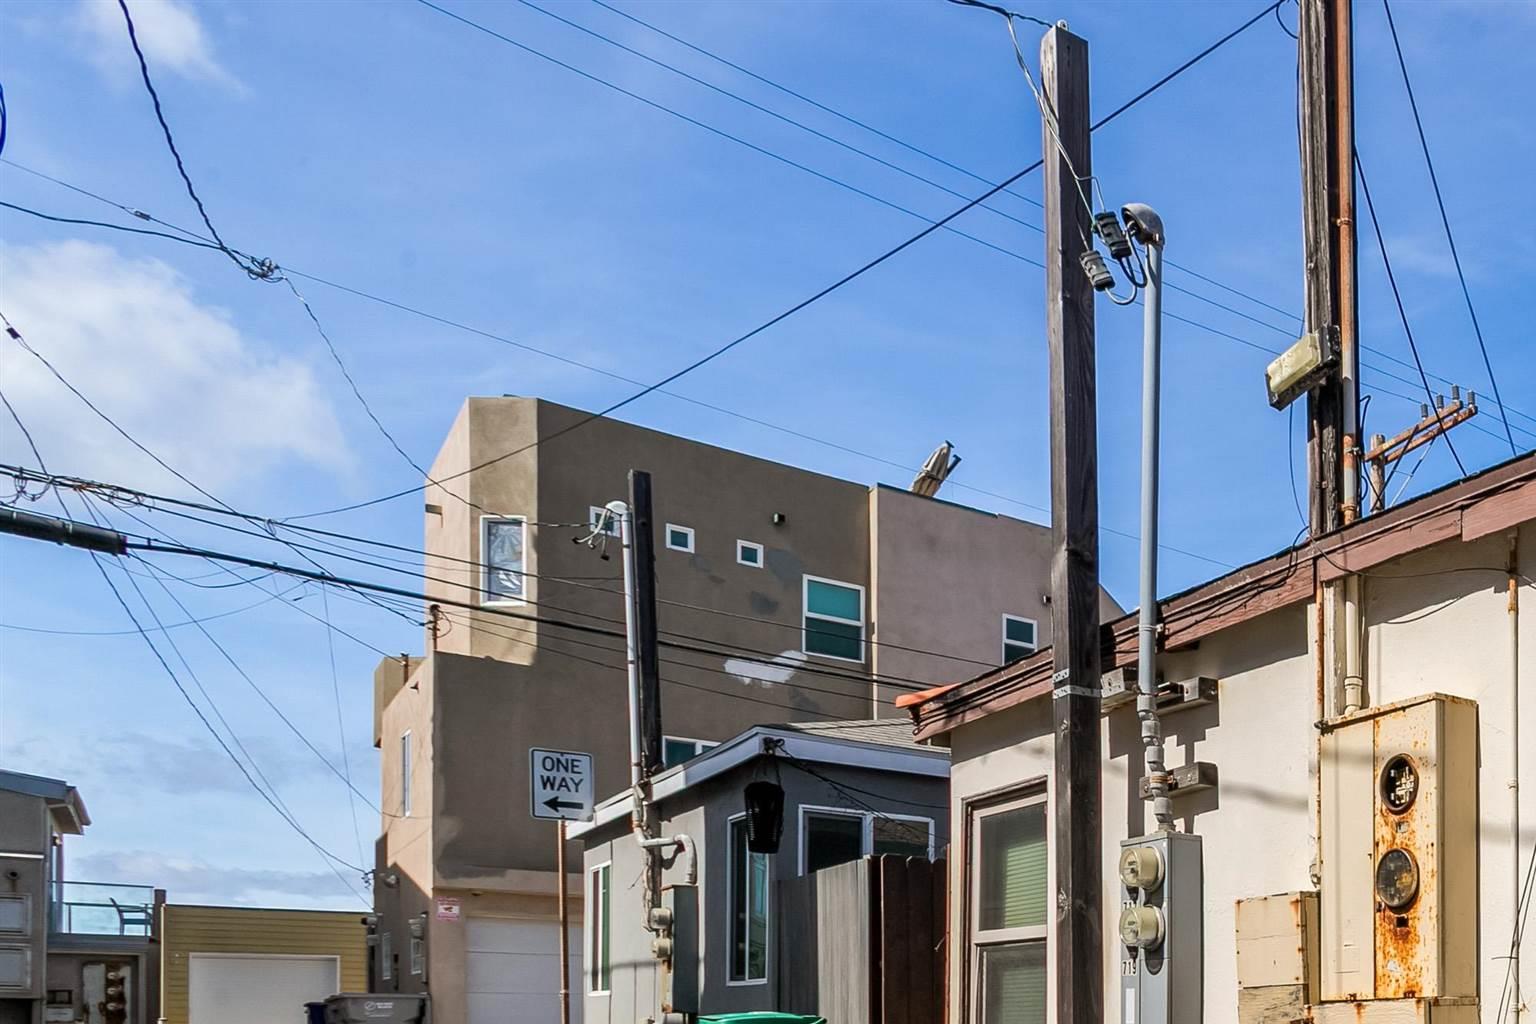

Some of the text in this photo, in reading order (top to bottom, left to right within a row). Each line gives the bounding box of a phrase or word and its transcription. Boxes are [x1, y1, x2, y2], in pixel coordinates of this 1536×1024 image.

[542, 756, 582, 774] ONE
[540, 774, 583, 792] WAY
[1122, 960, 1137, 975] 719
